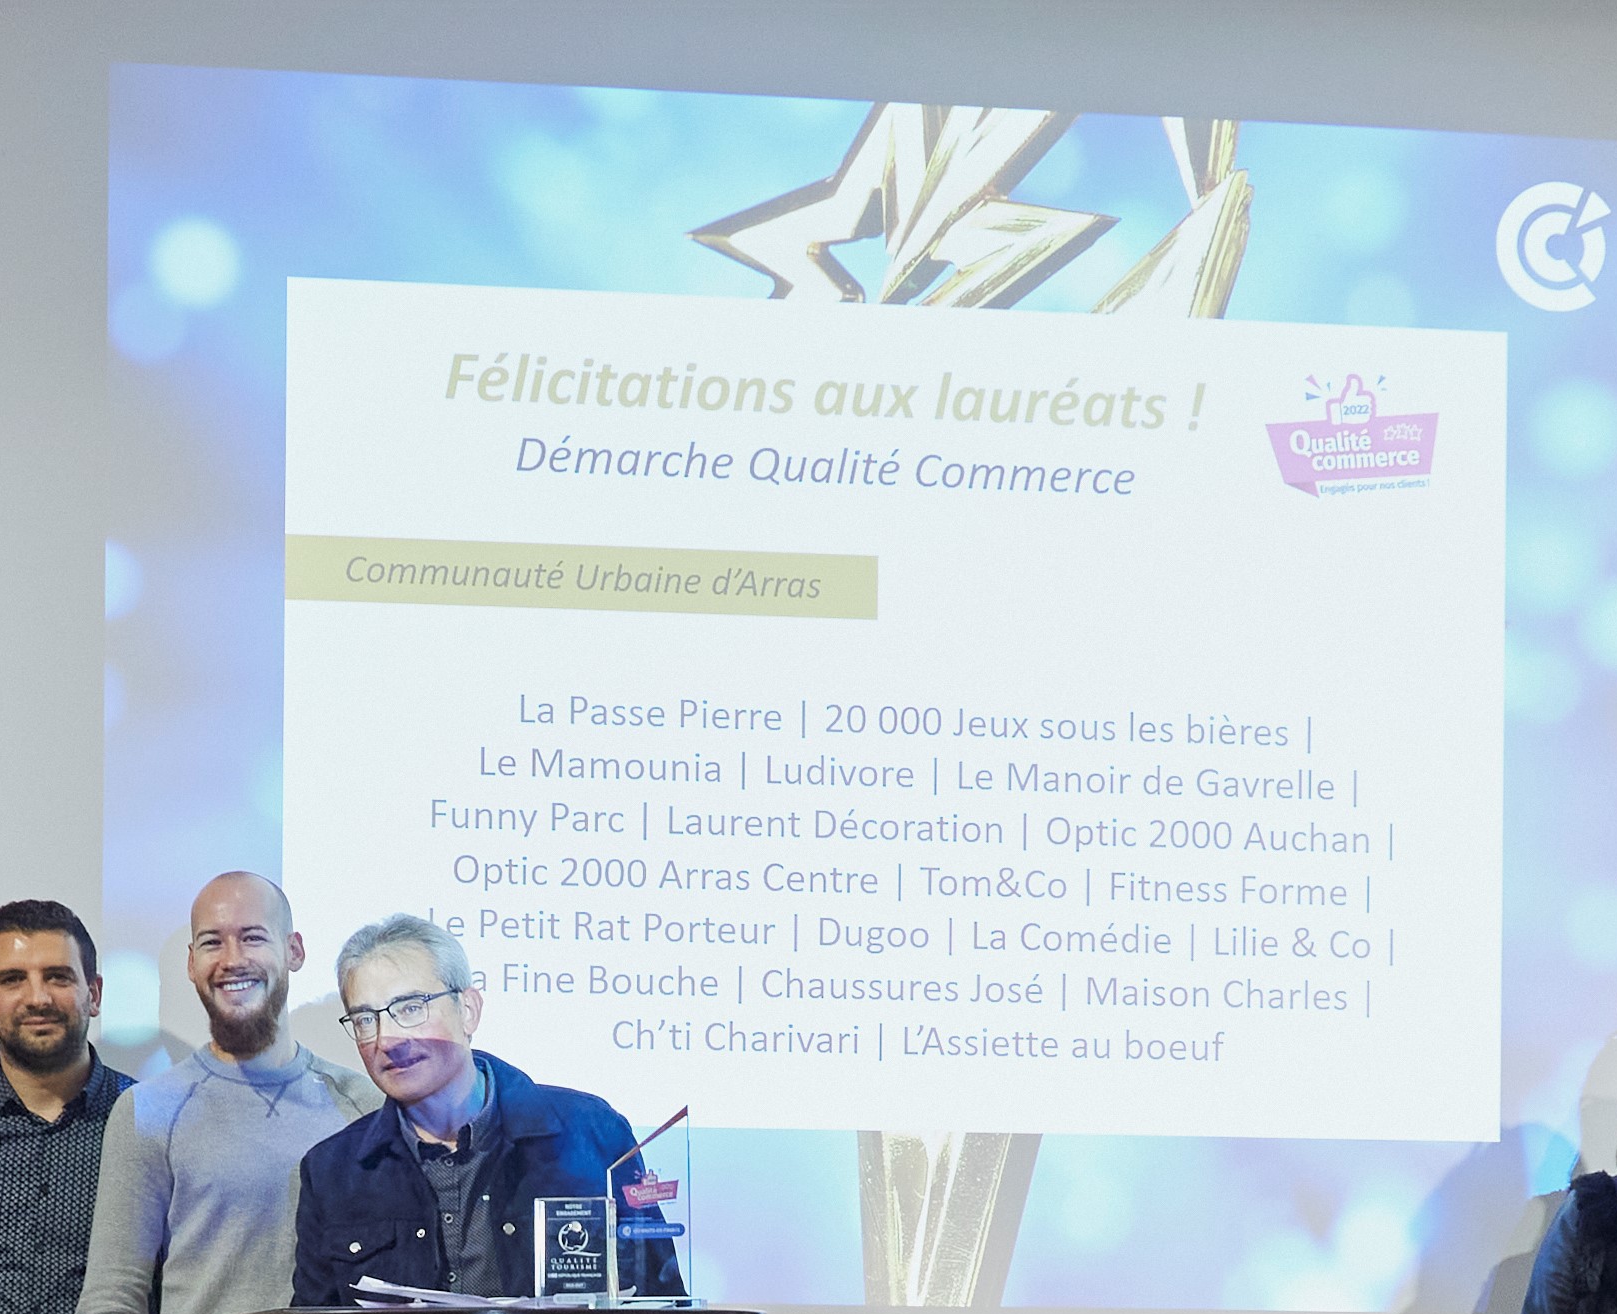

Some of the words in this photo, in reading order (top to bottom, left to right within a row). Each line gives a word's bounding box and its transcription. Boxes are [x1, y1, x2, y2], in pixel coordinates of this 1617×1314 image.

[445, 352, 795, 413] Félicitations
[815, 381, 918, 418] aux
[935, 372, 1166, 429] lauréats
[1188, 384, 1205, 430] !
[1343, 405, 1369, 415] 2022
[515, 434, 734, 480] Démarche
[748, 447, 900, 487] Qualité
[915, 454, 1135, 496] Commerce
[1290, 429, 1371, 457] Qualité
[1312, 449, 1420, 471] commerce
[345, 556, 565, 590] Communauté
[577, 564, 702, 595] Urbaine
[519, 693, 554, 725] La
[569, 695, 666, 728] Passe
[679, 699, 782, 732] Pierre
[825, 703, 867, 734] 20
[878, 705, 942, 737] 000
[952, 707, 1029, 739] Jeux
[1039, 718, 1116, 742] sous
[1129, 711, 1174, 744] les
[1187, 713, 1289, 747] bières
[480, 746, 517, 777] Le
[531, 748, 721, 783] Mamounia
[766, 754, 914, 789] Ludivore
[958, 761, 993, 791] Le
[1007, 762, 1132, 795] Manoir
[1142, 764, 1183, 796] de
[1196, 768, 1335, 801] Gavrelle
[430, 798, 538, 838] Funny
[550, 802, 624, 834] Parc
[668, 805, 801, 839] Laurent
[814, 808, 1003, 844] Décoration
[1046, 816, 1137, 853] Optic
[1149, 819, 1232, 850] 2000
[1243, 822, 1370, 854] Auchan
[453, 854, 548, 892] Optic
[560, 857, 647, 889] 2000
[658, 860, 750, 892] Arras
[763, 862, 878, 895] Centre
[919, 866, 1067, 899] Tom&Co
[1110, 871, 1227, 904] Fitness
[1241, 875, 1347, 907] Forme
[479, 908, 560, 941] Petit
[574, 911, 631, 942] Rat
[644, 912, 777, 945] Porteur
[819, 917, 929, 955] Dugoo
[973, 921, 1006, 951] La
[1020, 922, 1171, 955] Comédie
[1215, 925, 1278, 957] Lilie
[1291, 927, 1317, 958] &
[1330, 930, 1371, 959] Co
[503, 963, 575, 994] Fine
[589, 964, 719, 997] Bouche
[761, 967, 959, 1002] Chaussures
[969, 973, 1043, 1004] José
[1086, 976, 1210, 1008] Maison
[1223, 978, 1347, 1011] Charles
[704, 1020, 860, 1055] Charivari
[1071, 1038, 1110, 1059] au
[1125, 1029, 1225, 1061] boeuf
